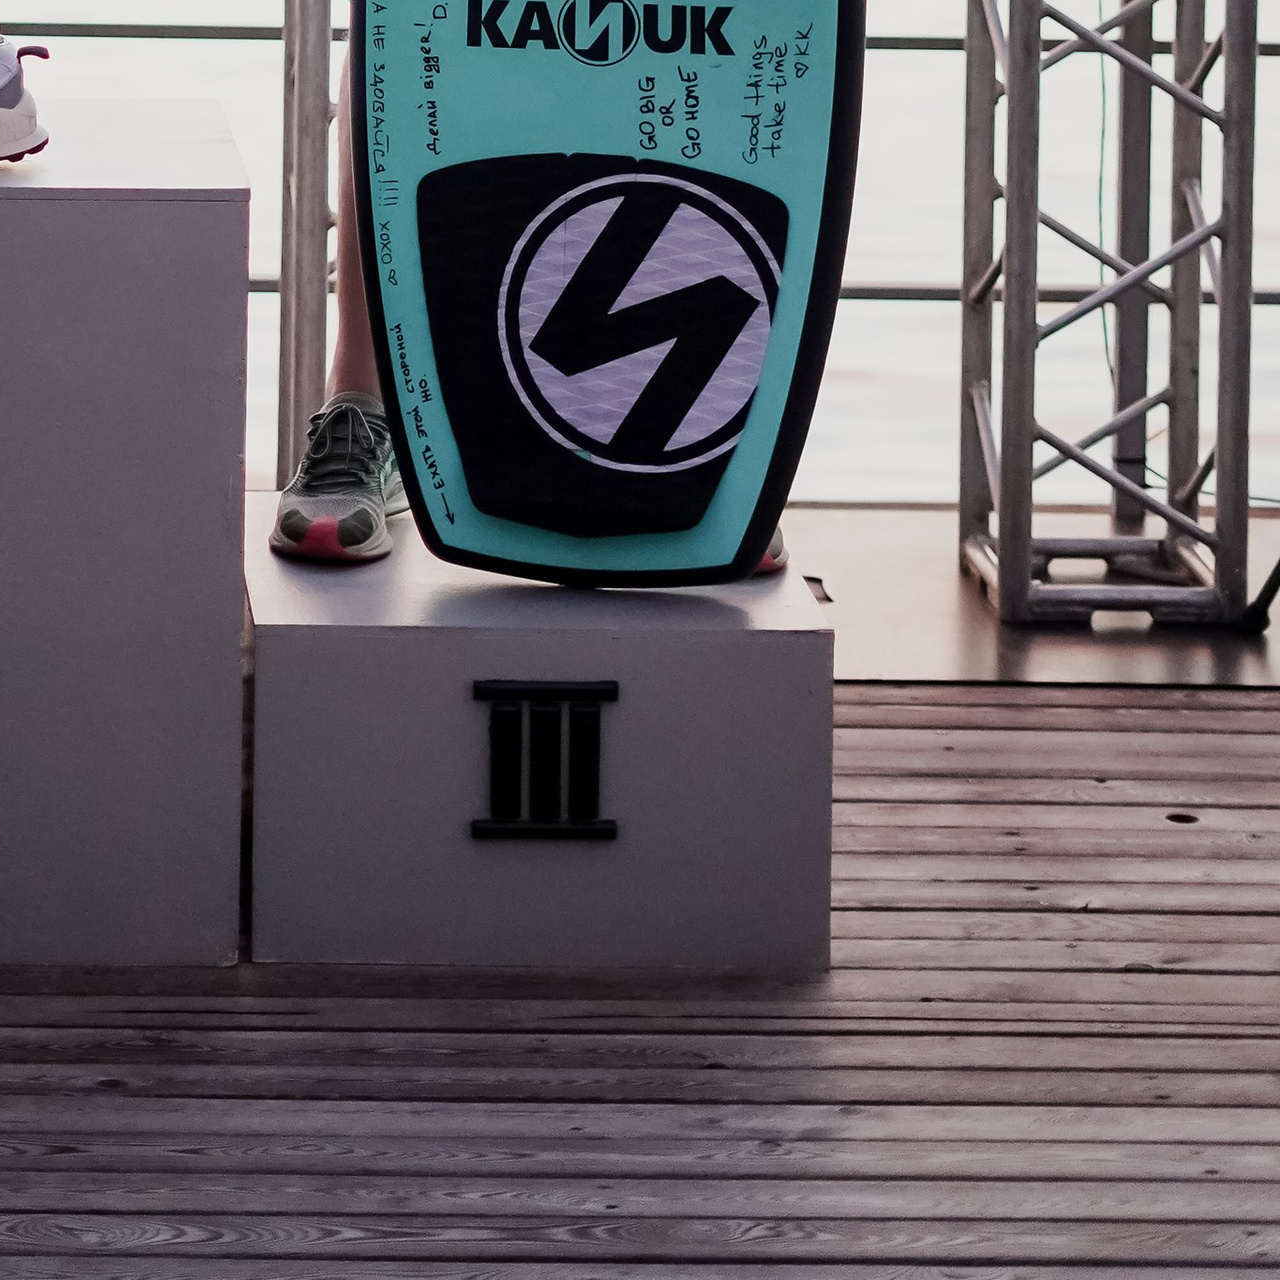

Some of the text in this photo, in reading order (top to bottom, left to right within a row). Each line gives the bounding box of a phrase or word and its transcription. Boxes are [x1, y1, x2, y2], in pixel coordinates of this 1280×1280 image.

[373, 24, 386, 51] НЕ
[638, 76, 658, 150] GO BIG
[658, 98, 676, 127] OR
[677, 65, 702, 159] GO HOME
[741, 34, 774, 165] Good things
[762, 41, 787, 158] take time
[421, 444, 445, 490] ЕХАТЬ
[470, 680, 620, 840] III
